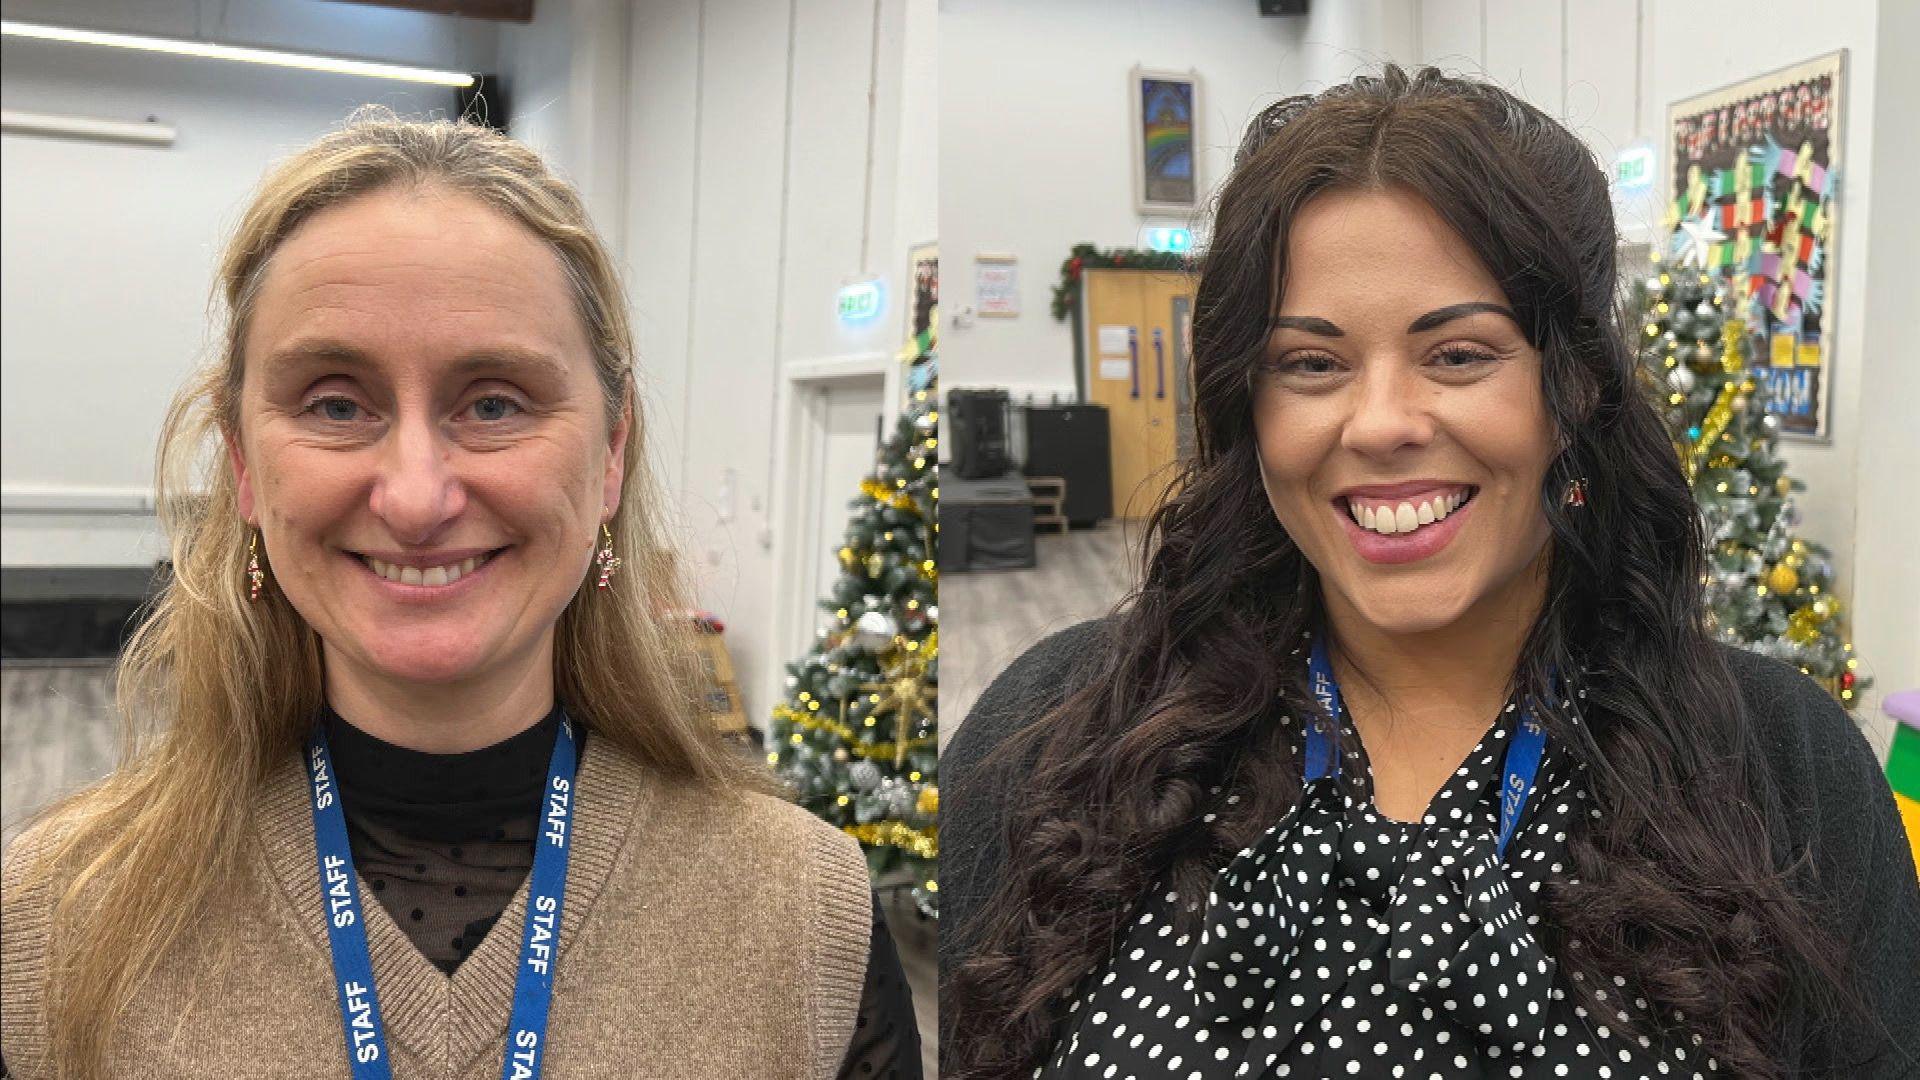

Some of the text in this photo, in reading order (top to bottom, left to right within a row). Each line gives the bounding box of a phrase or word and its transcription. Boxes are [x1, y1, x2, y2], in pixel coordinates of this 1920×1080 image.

[1314, 671, 1334, 735] AFF
[312, 745, 333, 811] STAFF
[545, 775, 570, 848] STAFF
[324, 855, 355, 929] STAFF
[527, 895, 557, 975] STAFF
[345, 981, 379, 1063] STAFF
